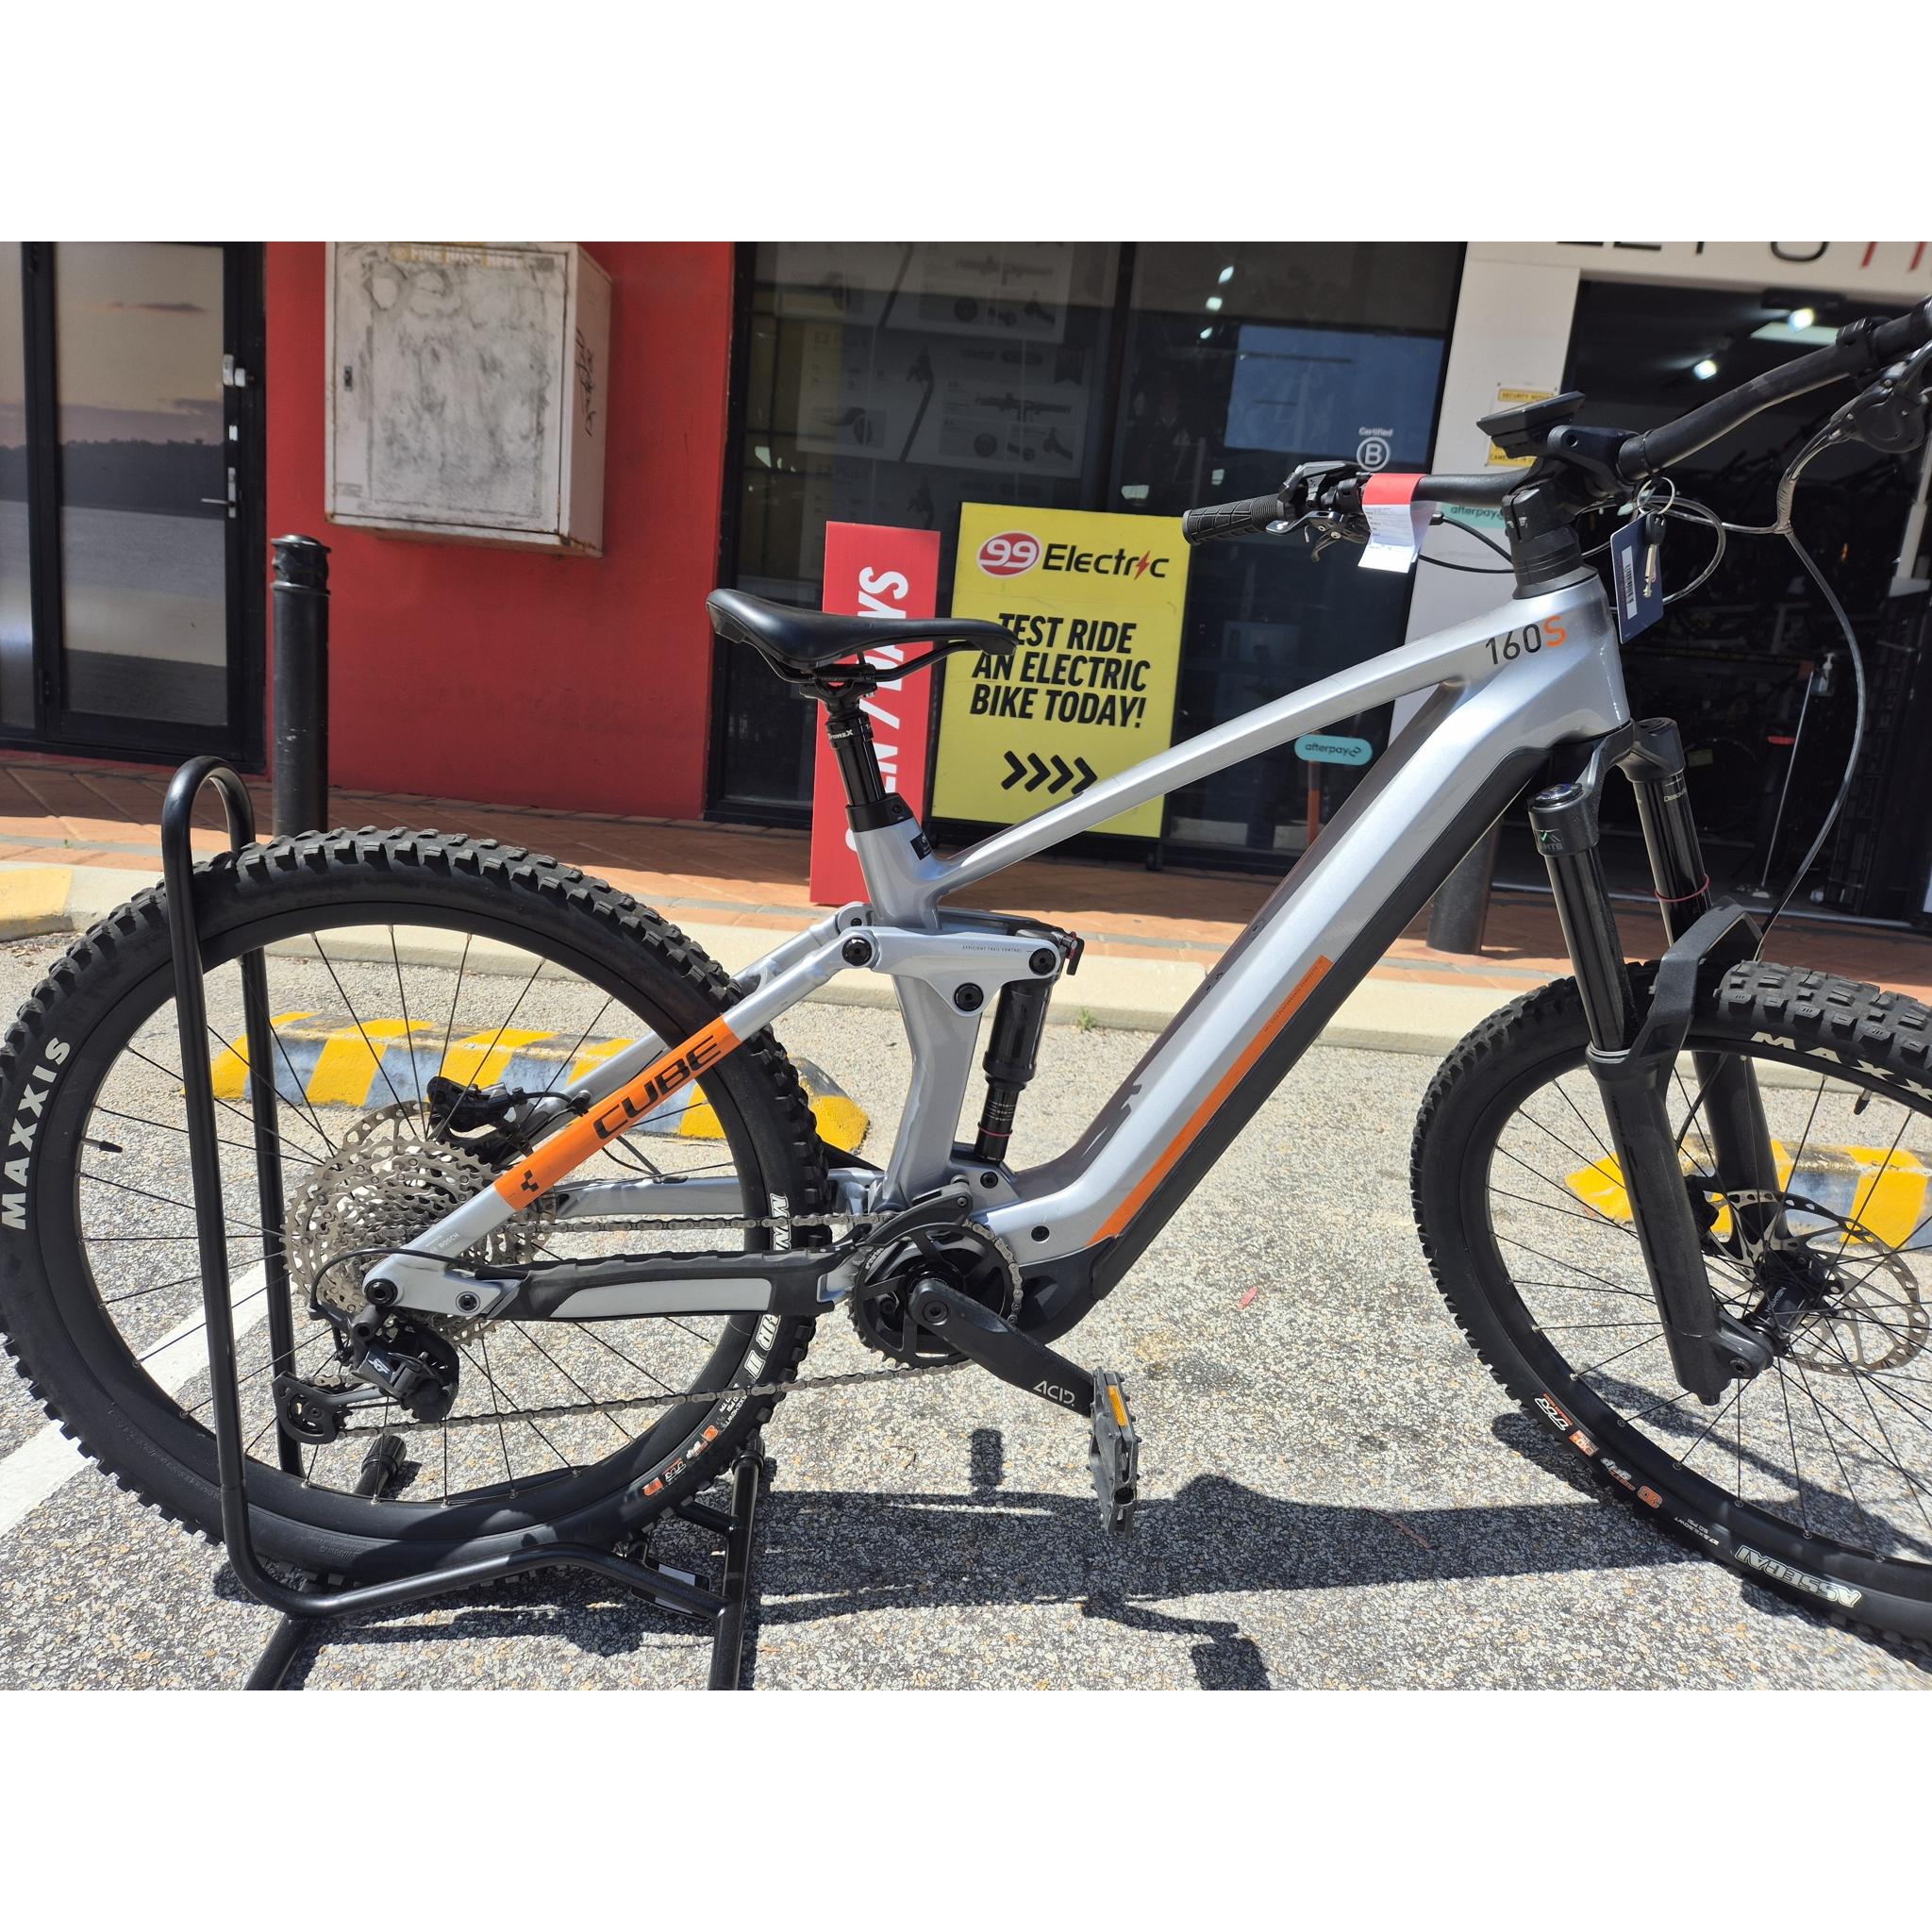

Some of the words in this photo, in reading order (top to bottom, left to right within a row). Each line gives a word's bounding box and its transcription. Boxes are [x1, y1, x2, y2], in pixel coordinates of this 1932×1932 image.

[1358, 426, 1393, 437] Certified
[1450, 505, 1497, 520] afterpay
[979, 538, 1040, 568] 99
[998, 612, 1064, 648] TEST
[1066, 618, 1137, 654] RIDE
[1485, 615, 1568, 665] 160S
[972, 651, 1015, 681] AN
[1020, 651, 1151, 691] ELECTRIC
[970, 683, 1039, 720] BIKE
[1044, 689, 1147, 729] TODAY!
[1305, 741, 1349, 757] afterpay
[592, 1035, 722, 1140] CUBE
[1, 1037, 71, 1230] MAXXIS
[1534, 1397, 1570, 1431] TR
[1734, 1544, 1863, 1608] ASSEGAI
